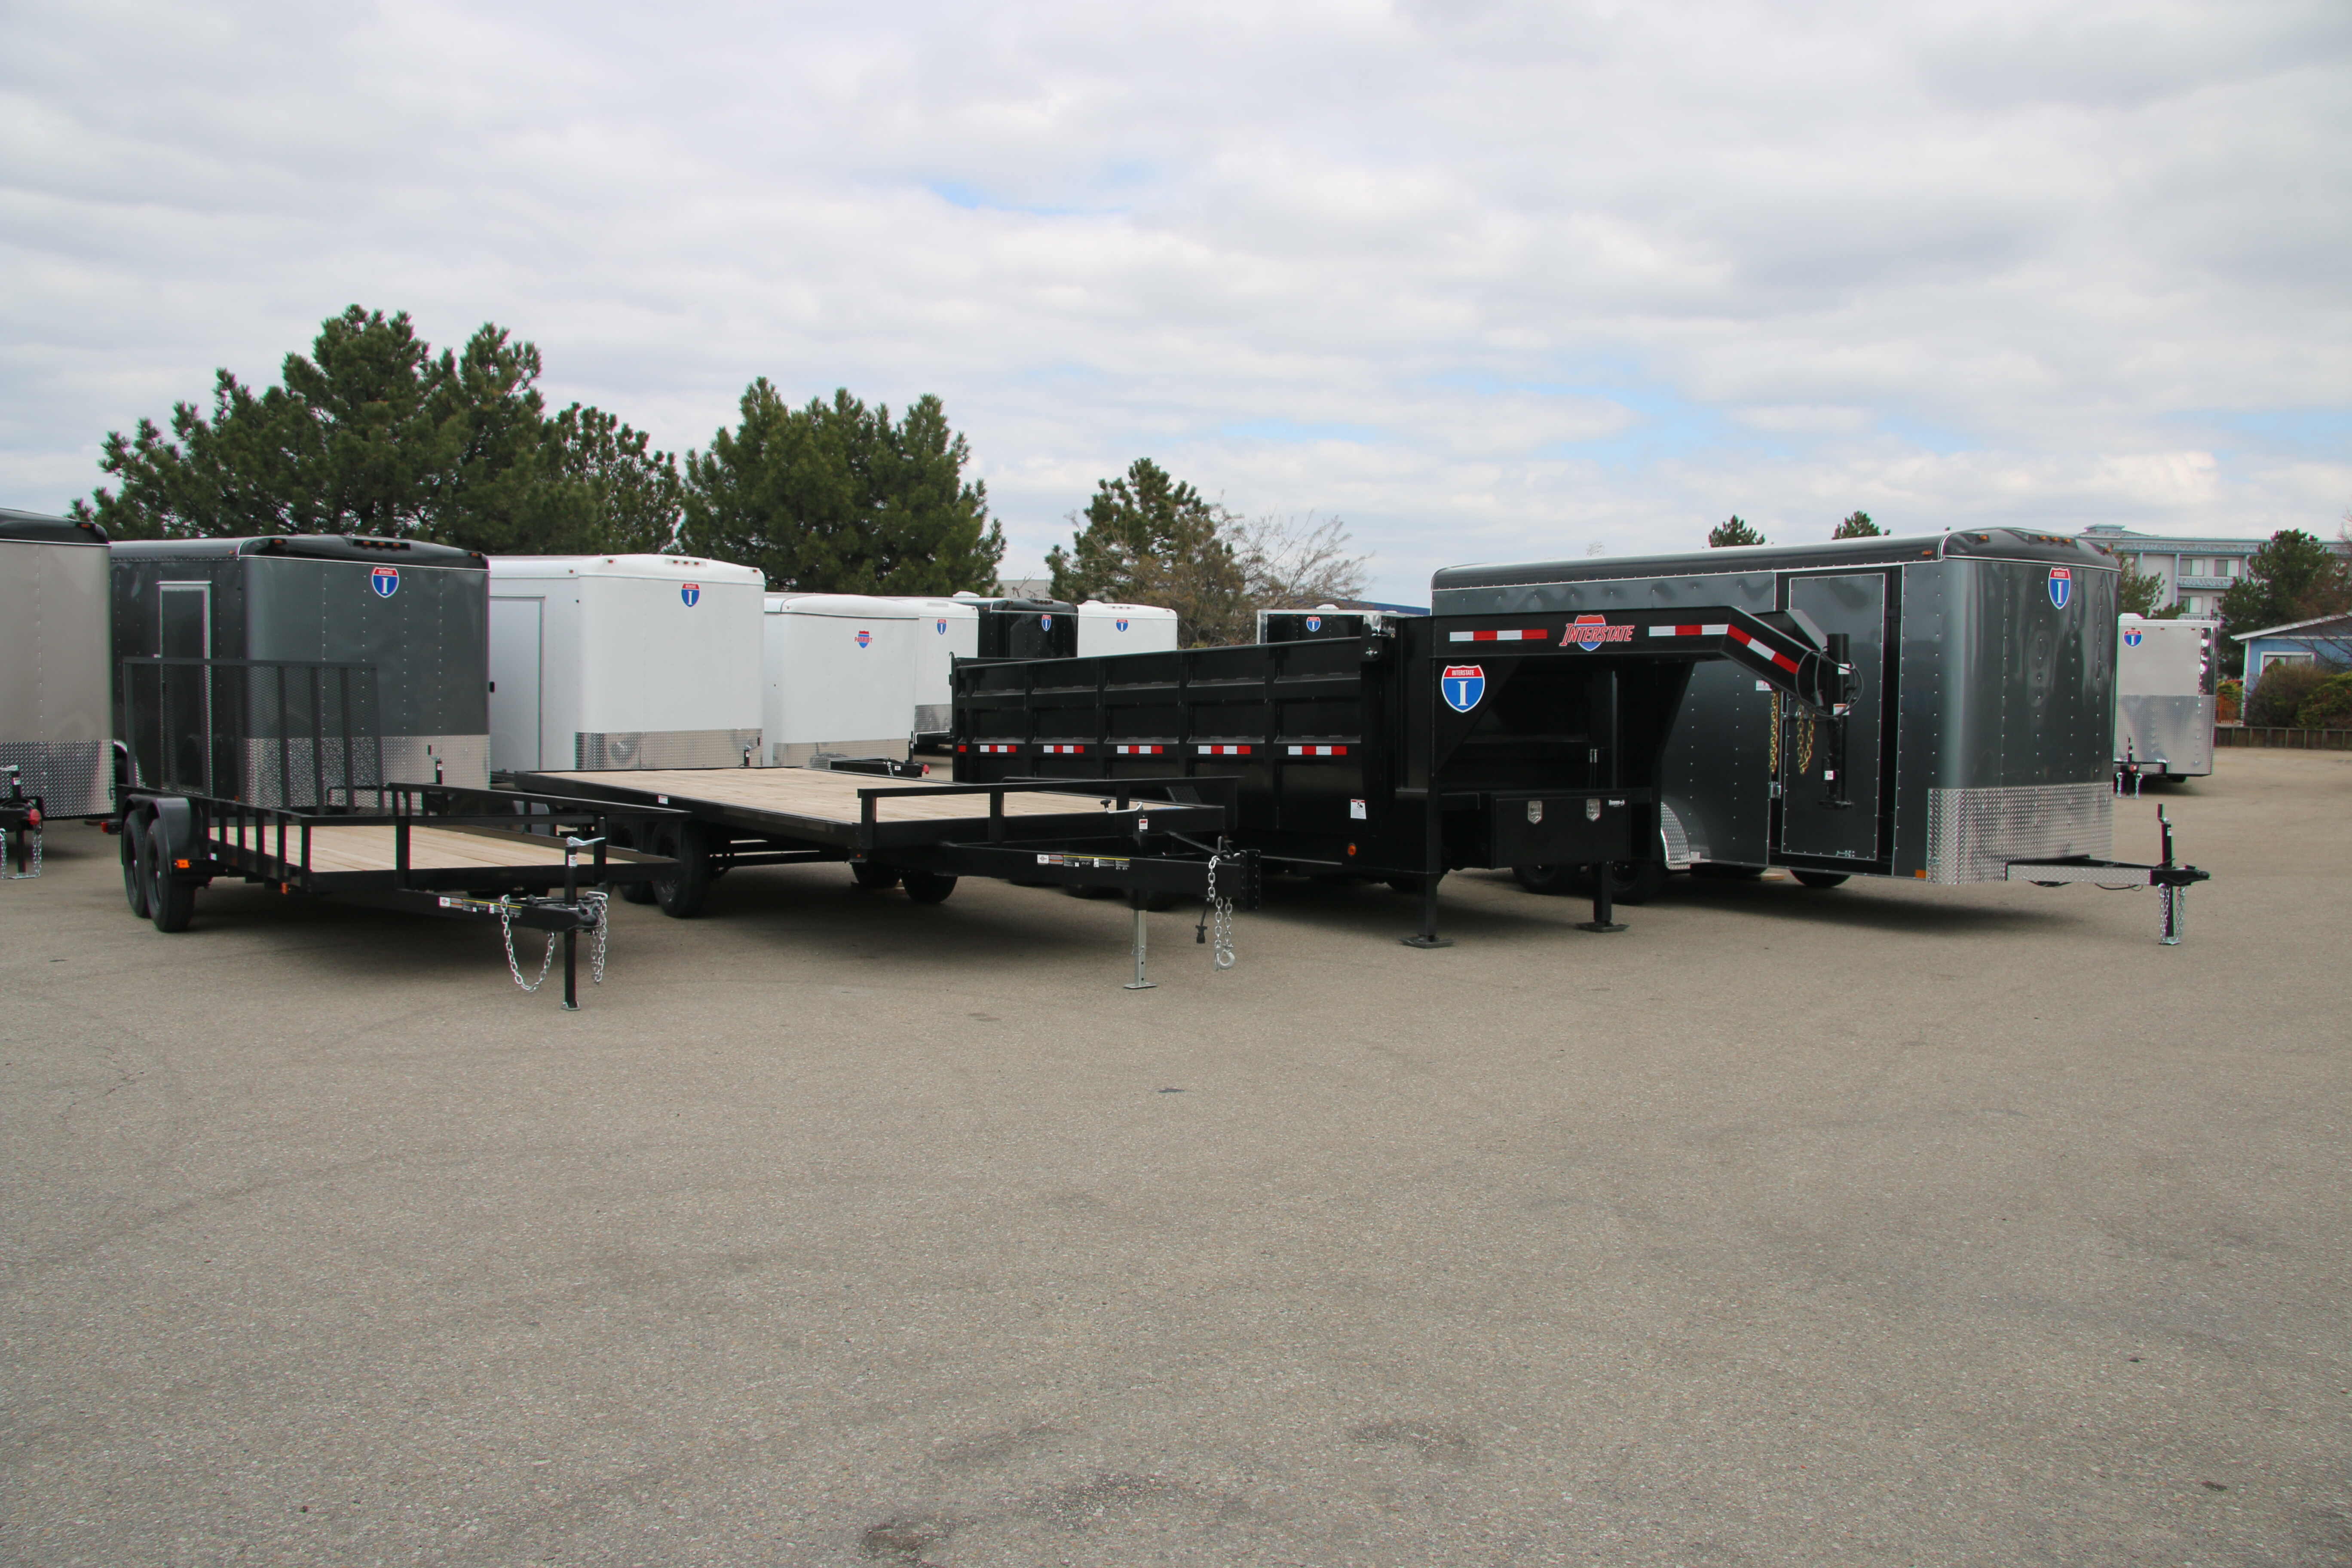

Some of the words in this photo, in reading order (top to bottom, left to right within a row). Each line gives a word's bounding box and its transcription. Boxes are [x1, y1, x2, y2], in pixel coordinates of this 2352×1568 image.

[381, 577, 389, 594] I
[2057, 582, 2063, 603] I
[688, 591, 693, 605] I
[1559, 623, 1635, 646] INTERSTATE
[1458, 681, 1468, 706] I
